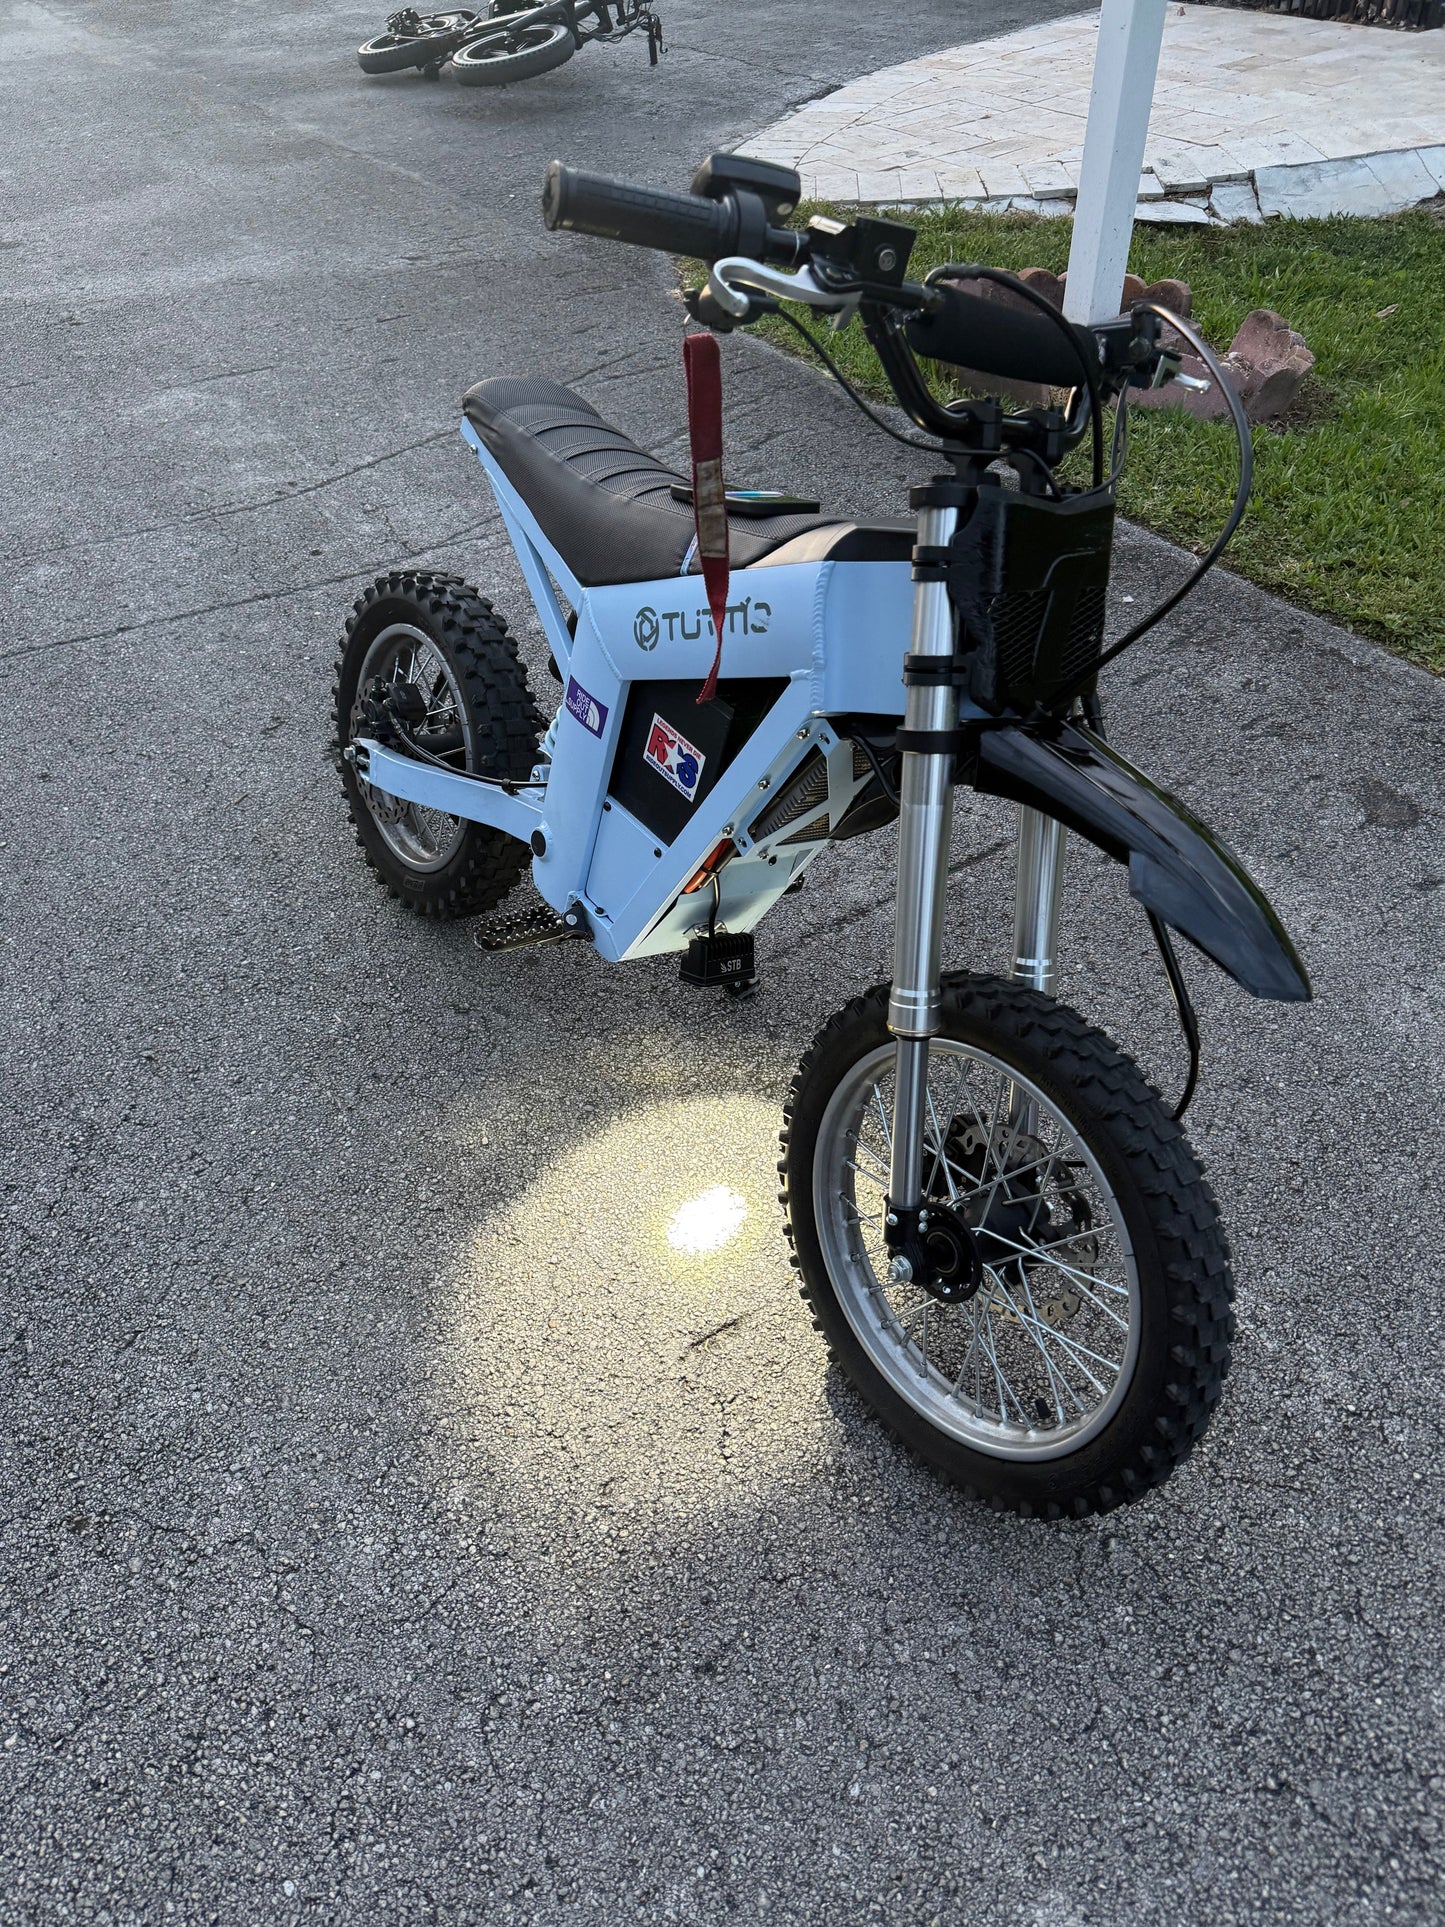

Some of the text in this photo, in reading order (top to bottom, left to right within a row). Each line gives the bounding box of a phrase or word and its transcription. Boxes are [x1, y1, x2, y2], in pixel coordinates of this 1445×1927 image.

[576, 689, 591, 707] RIDE
[576, 698, 589, 713] OUT
[566, 697, 588, 721] SUPPLY
[656, 717, 678, 739] LEGENDS
[677, 736, 693, 754] NEVER
[645, 754, 692, 799] RIDEOUTSUPPLY.COM
[727, 959, 741, 972] STB
